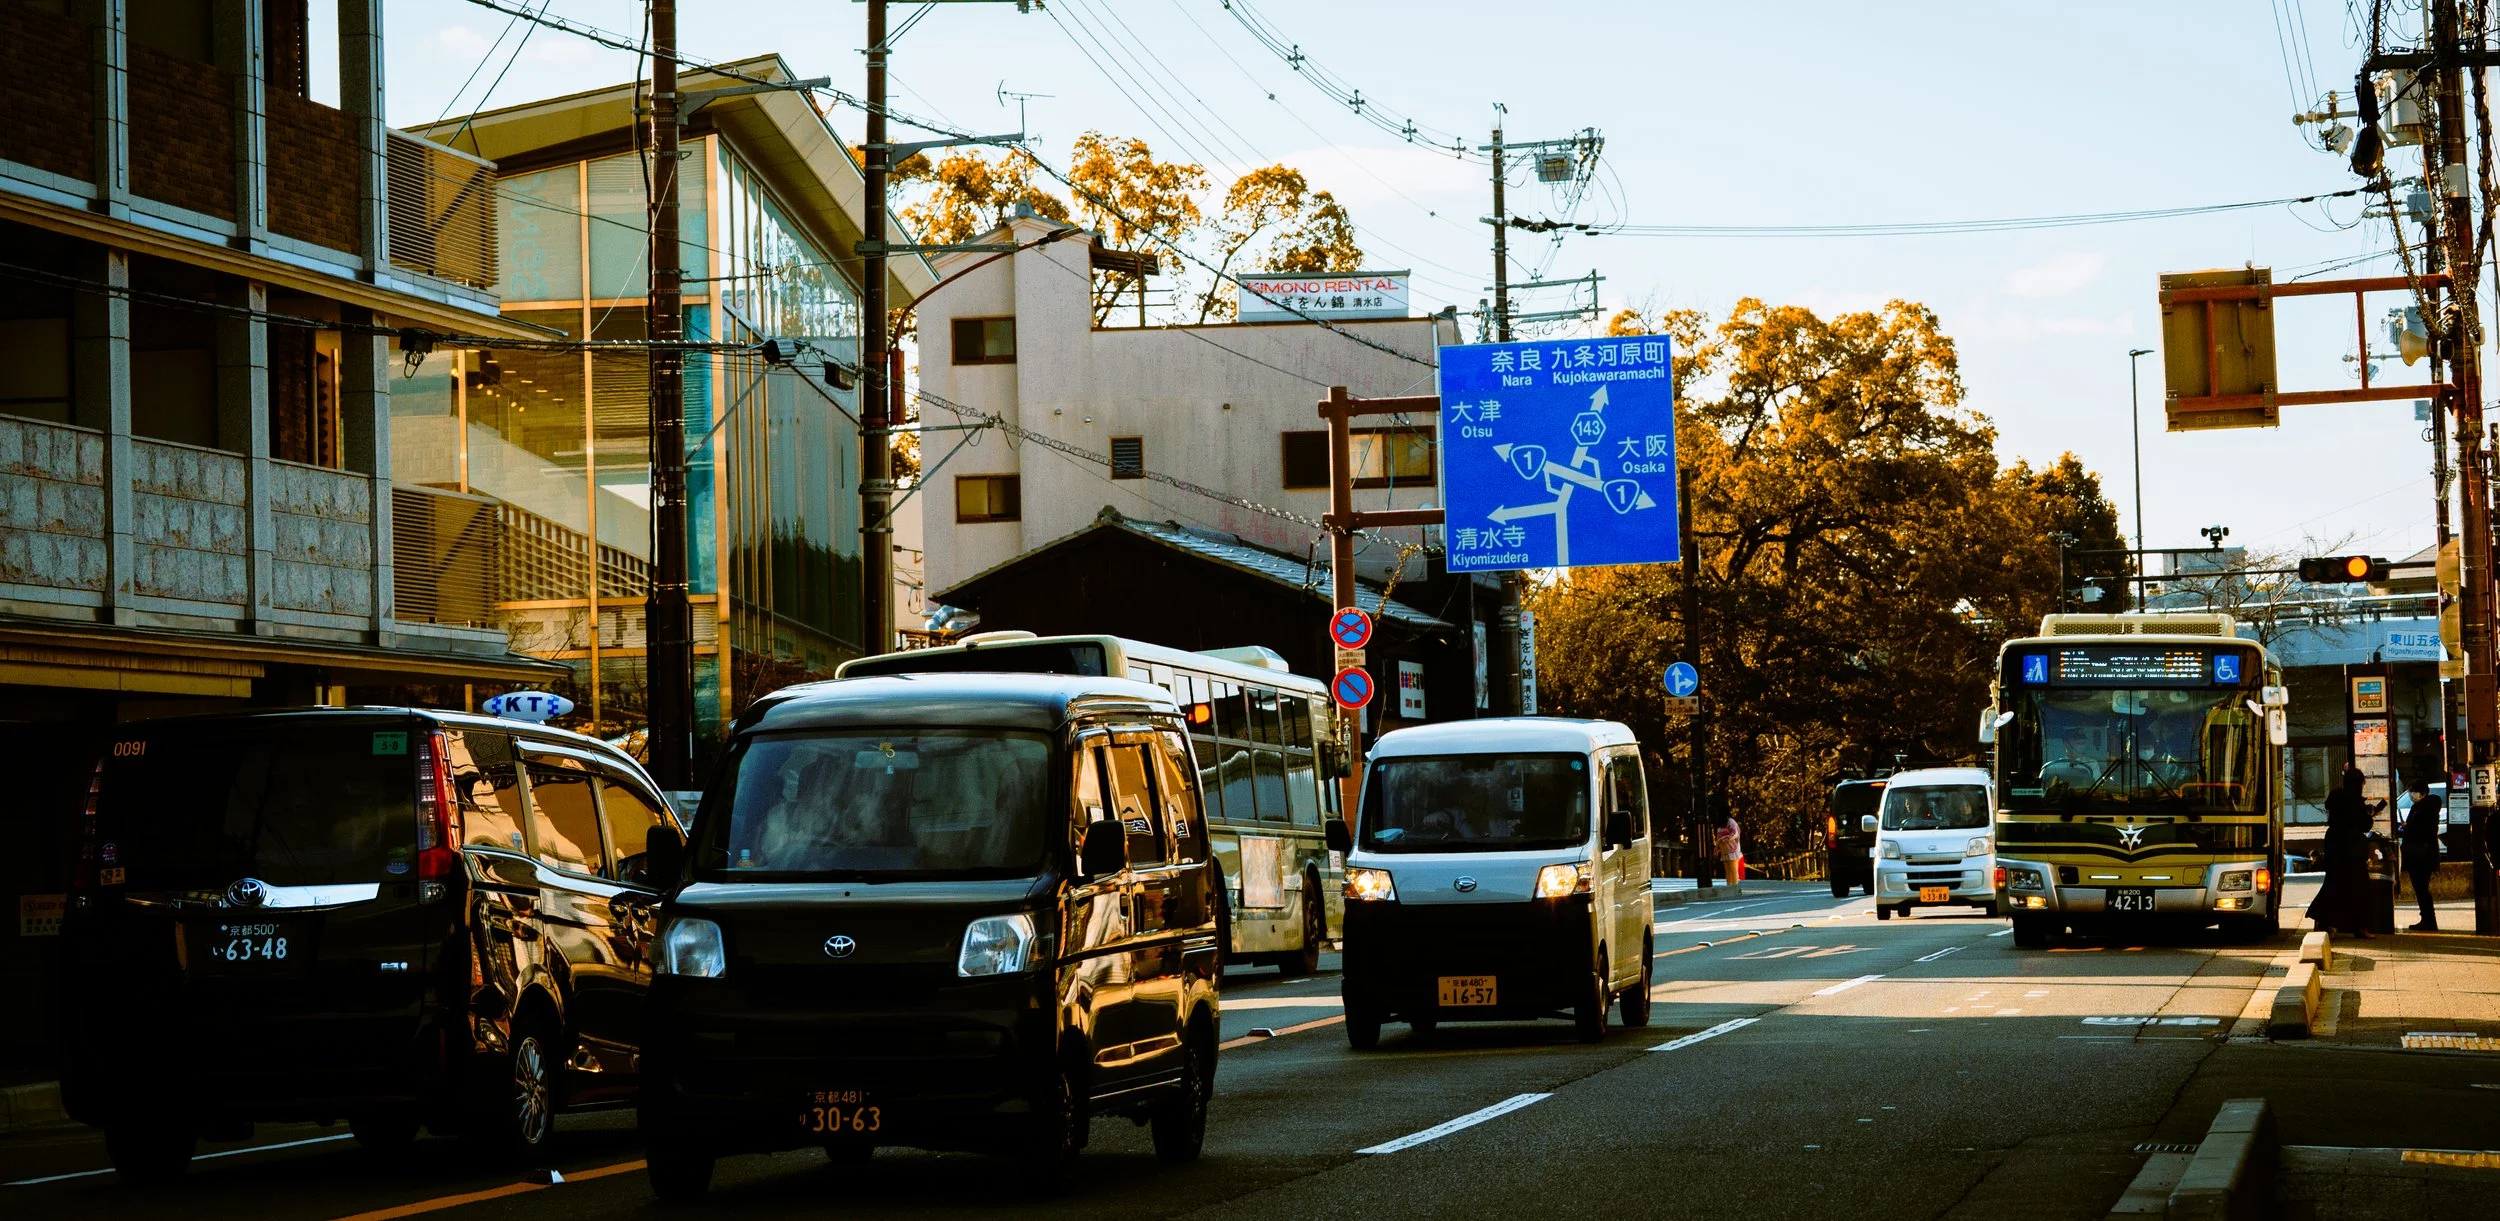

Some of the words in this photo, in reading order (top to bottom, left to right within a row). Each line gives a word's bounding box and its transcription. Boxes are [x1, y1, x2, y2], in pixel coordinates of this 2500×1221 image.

[1247, 282, 1321, 294] KIMONO
[1325, 279, 1399, 292] RENTAL
[1353, 297, 1382, 307] 清水店
[1492, 348, 1542, 373] 奈良
[1551, 342, 1665, 370] 九条河原町
[1502, 374, 1532, 387] Nara
[1552, 366, 1665, 384] Kujokawaramachi
[1450, 399, 1502, 424] 大津
[1461, 426, 1493, 439] Otsu
[1577, 420, 1600, 436] 143
[1617, 435, 1668, 460] 大阪
[1523, 451, 1533, 470] 1
[1623, 461, 1666, 475] Osaka
[1616, 485, 1626, 504] 1
[1456, 526, 1526, 551] 清水寺
[1452, 553, 1529, 569] Kiyomizudera
[2390, 634, 2440, 647] 東山五条
[2388, 647, 2440, 657] Higashiyamagoj
[114, 741, 147, 757] 0091
[2115, 895, 2153, 910] 42-13
[226, 937, 288, 960] 63-48
[1453, 988, 1494, 1004] 16-57
[812, 1106, 881, 1132] 30-63
